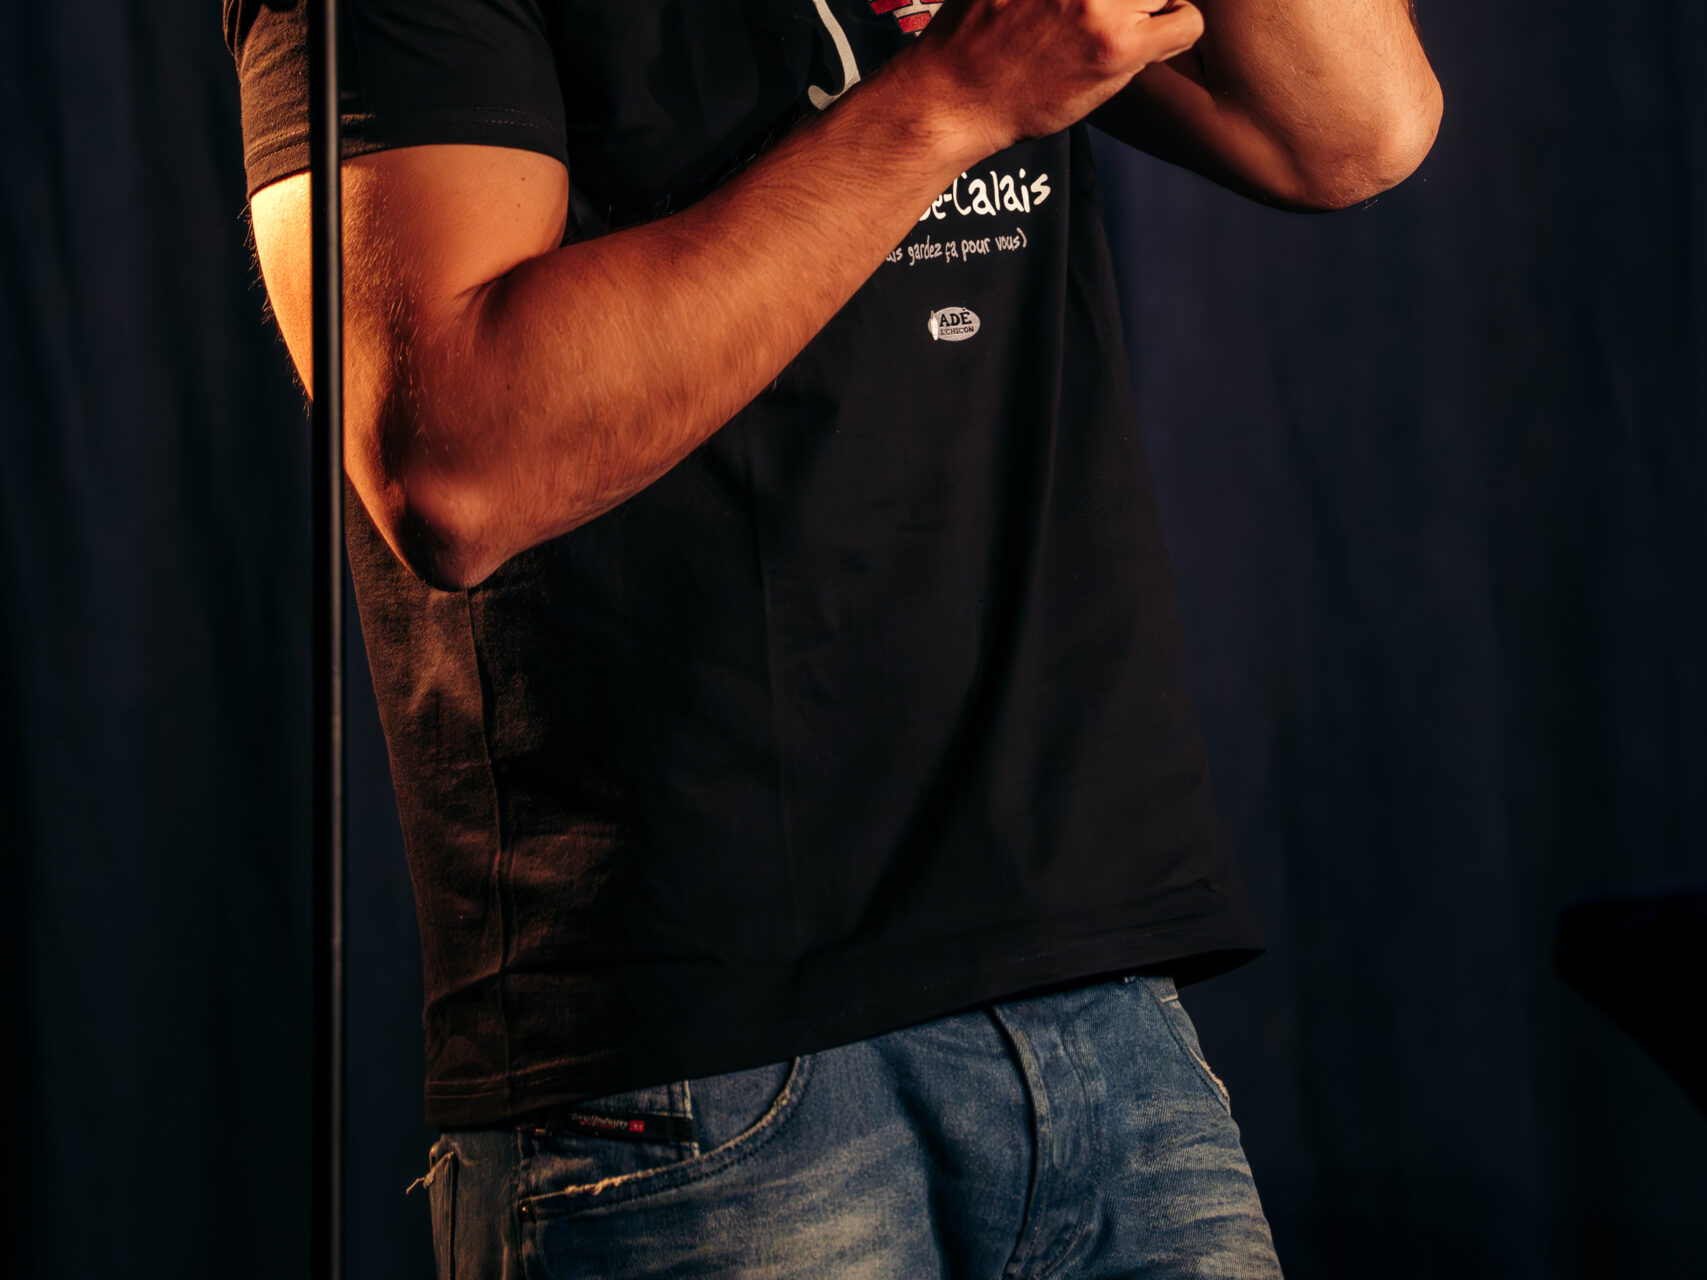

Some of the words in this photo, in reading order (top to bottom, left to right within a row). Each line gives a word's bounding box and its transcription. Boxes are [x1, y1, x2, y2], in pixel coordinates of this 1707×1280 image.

[907, 235, 943, 266] gardez
[945, 240, 958, 263] ça
[961, 237, 991, 262] pour
[995, 227, 1028, 251] vous)
